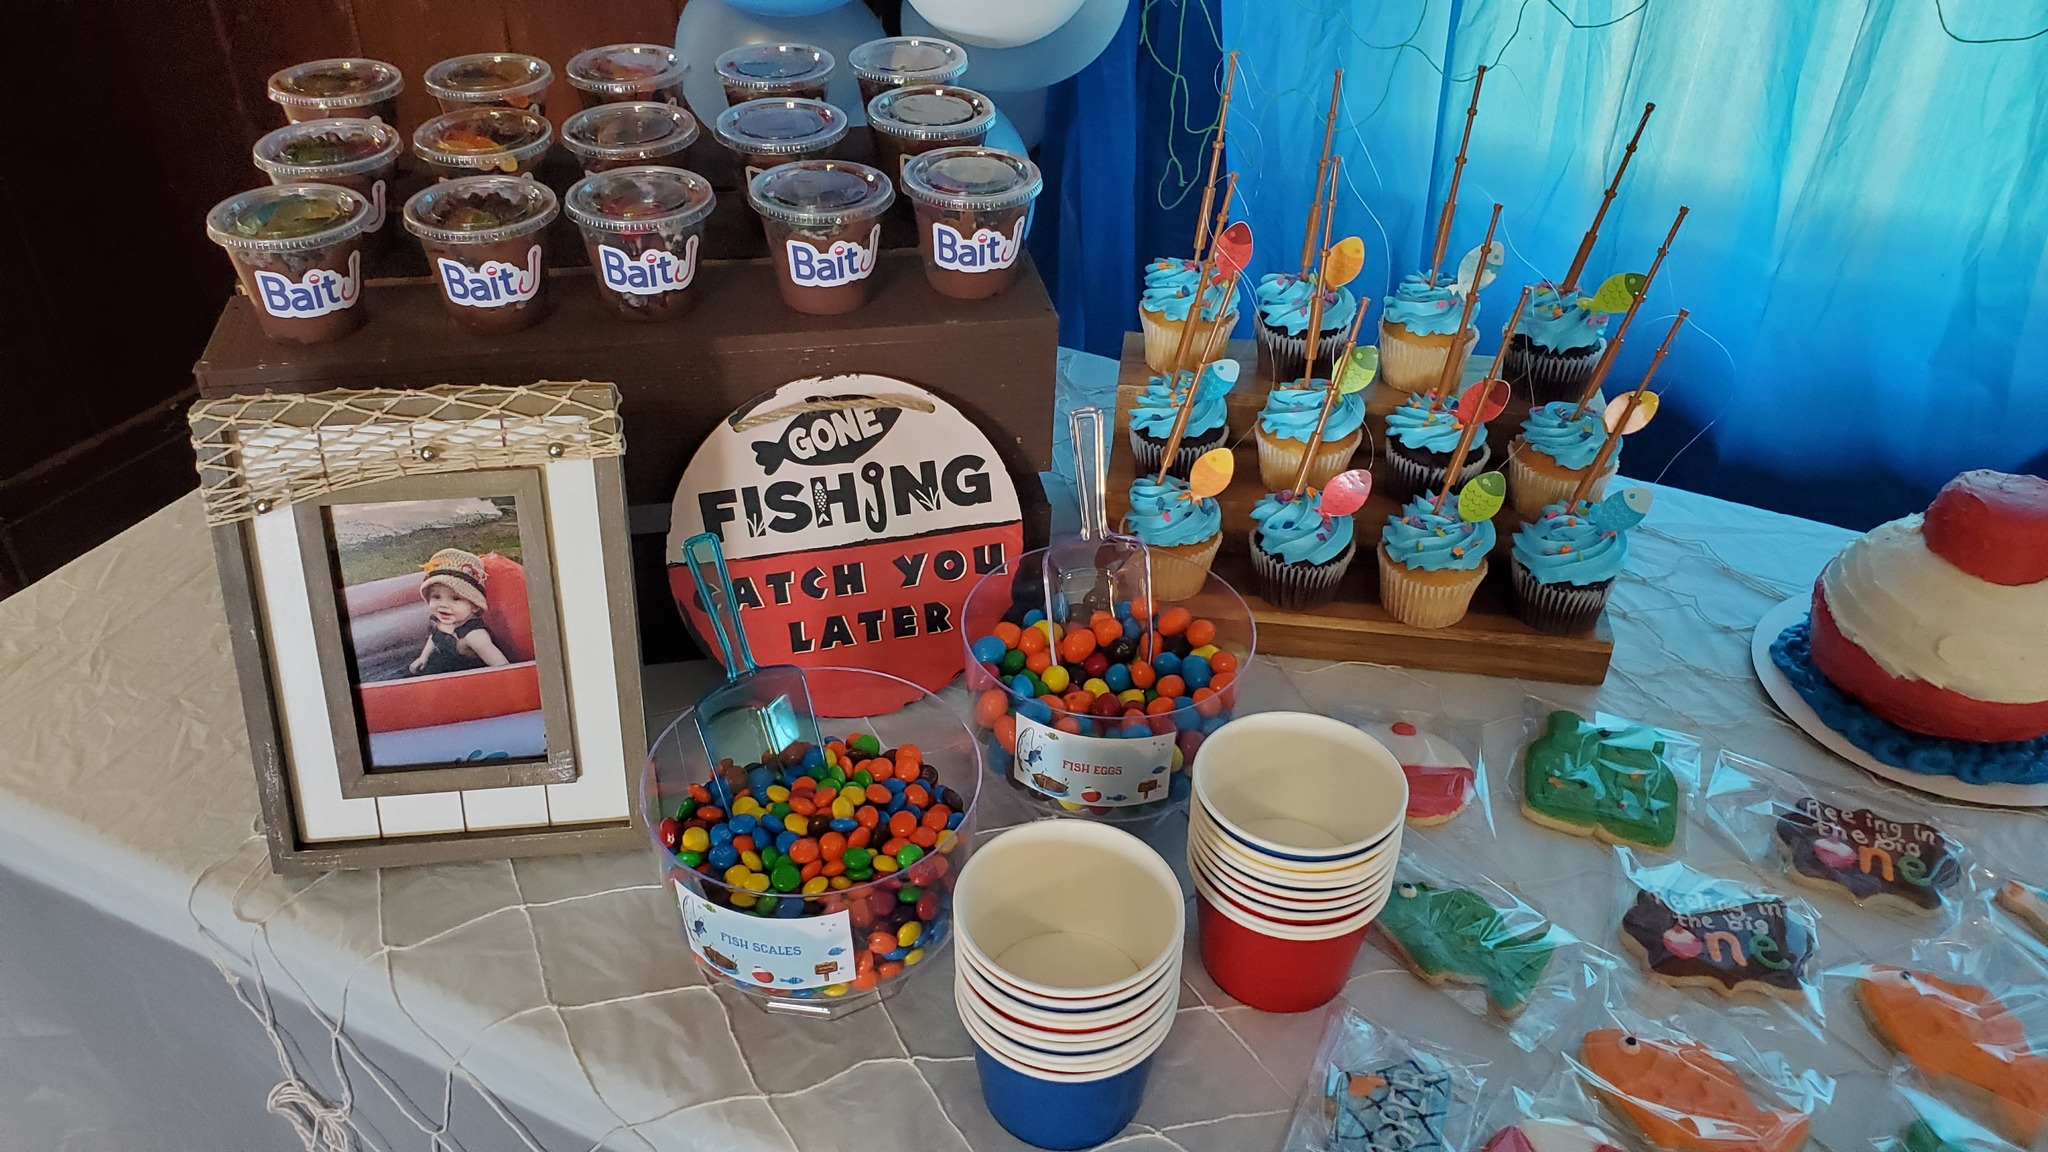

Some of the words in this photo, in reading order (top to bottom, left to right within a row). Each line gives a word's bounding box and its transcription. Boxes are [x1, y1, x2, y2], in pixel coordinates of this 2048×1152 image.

[791, 244, 861, 282] Bait
[937, 227, 1002, 267] Bait
[442, 262, 519, 300] Bait
[604, 249, 674, 289] Bait
[260, 273, 341, 312] Bait
[788, 407, 884, 459] GONE
[698, 455, 992, 543] FISHING
[893, 543, 1008, 589] YOU
[788, 601, 954, 654] LATER
[1062, 760, 1090, 775] FISH
[1093, 765, 1123, 776] EGGS
[1913, 823, 1936, 846] in
[1672, 912, 1716, 929] the
[1757, 901, 1784, 918] in
[719, 931, 749, 950] FISH
[752, 942, 803, 956] SCALES
